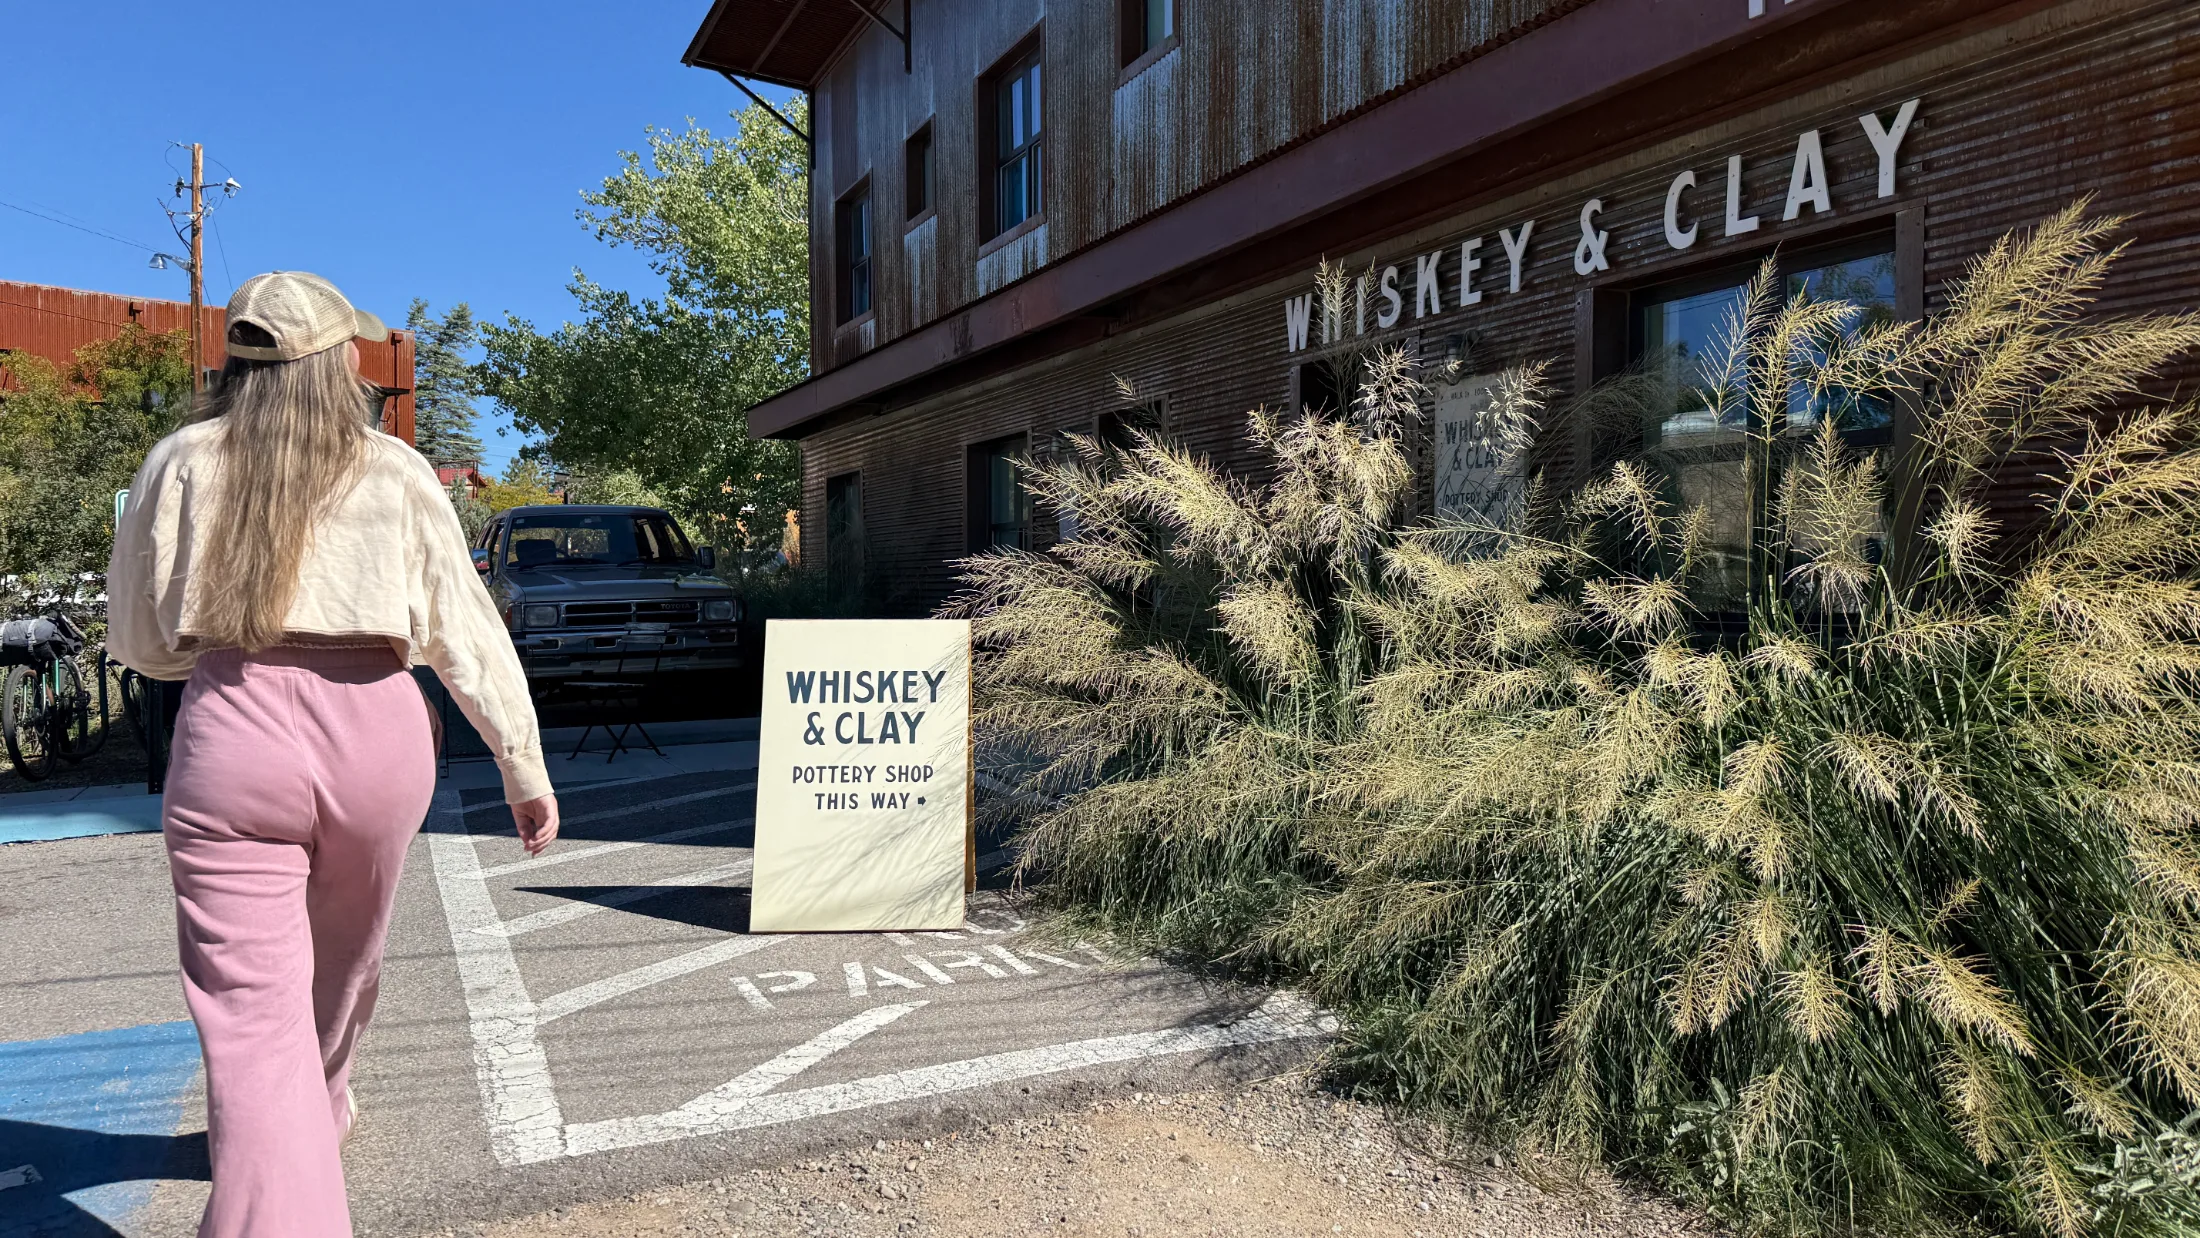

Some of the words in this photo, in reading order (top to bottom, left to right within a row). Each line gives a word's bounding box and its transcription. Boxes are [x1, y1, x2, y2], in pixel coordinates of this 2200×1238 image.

[1285, 220, 1535, 353] WHISKEY
[1574, 199, 1609, 276] &
[1663, 99, 1921, 250] CLAY
[786, 671, 947, 704] WHISKEY
[803, 712, 825, 745] &
[835, 711, 926, 744] CLAY
[792, 766, 876, 783] POTTERY
[885, 765, 934, 782] SHOP
[815, 793, 859, 810] THIS
[871, 793, 910, 809] WAY
